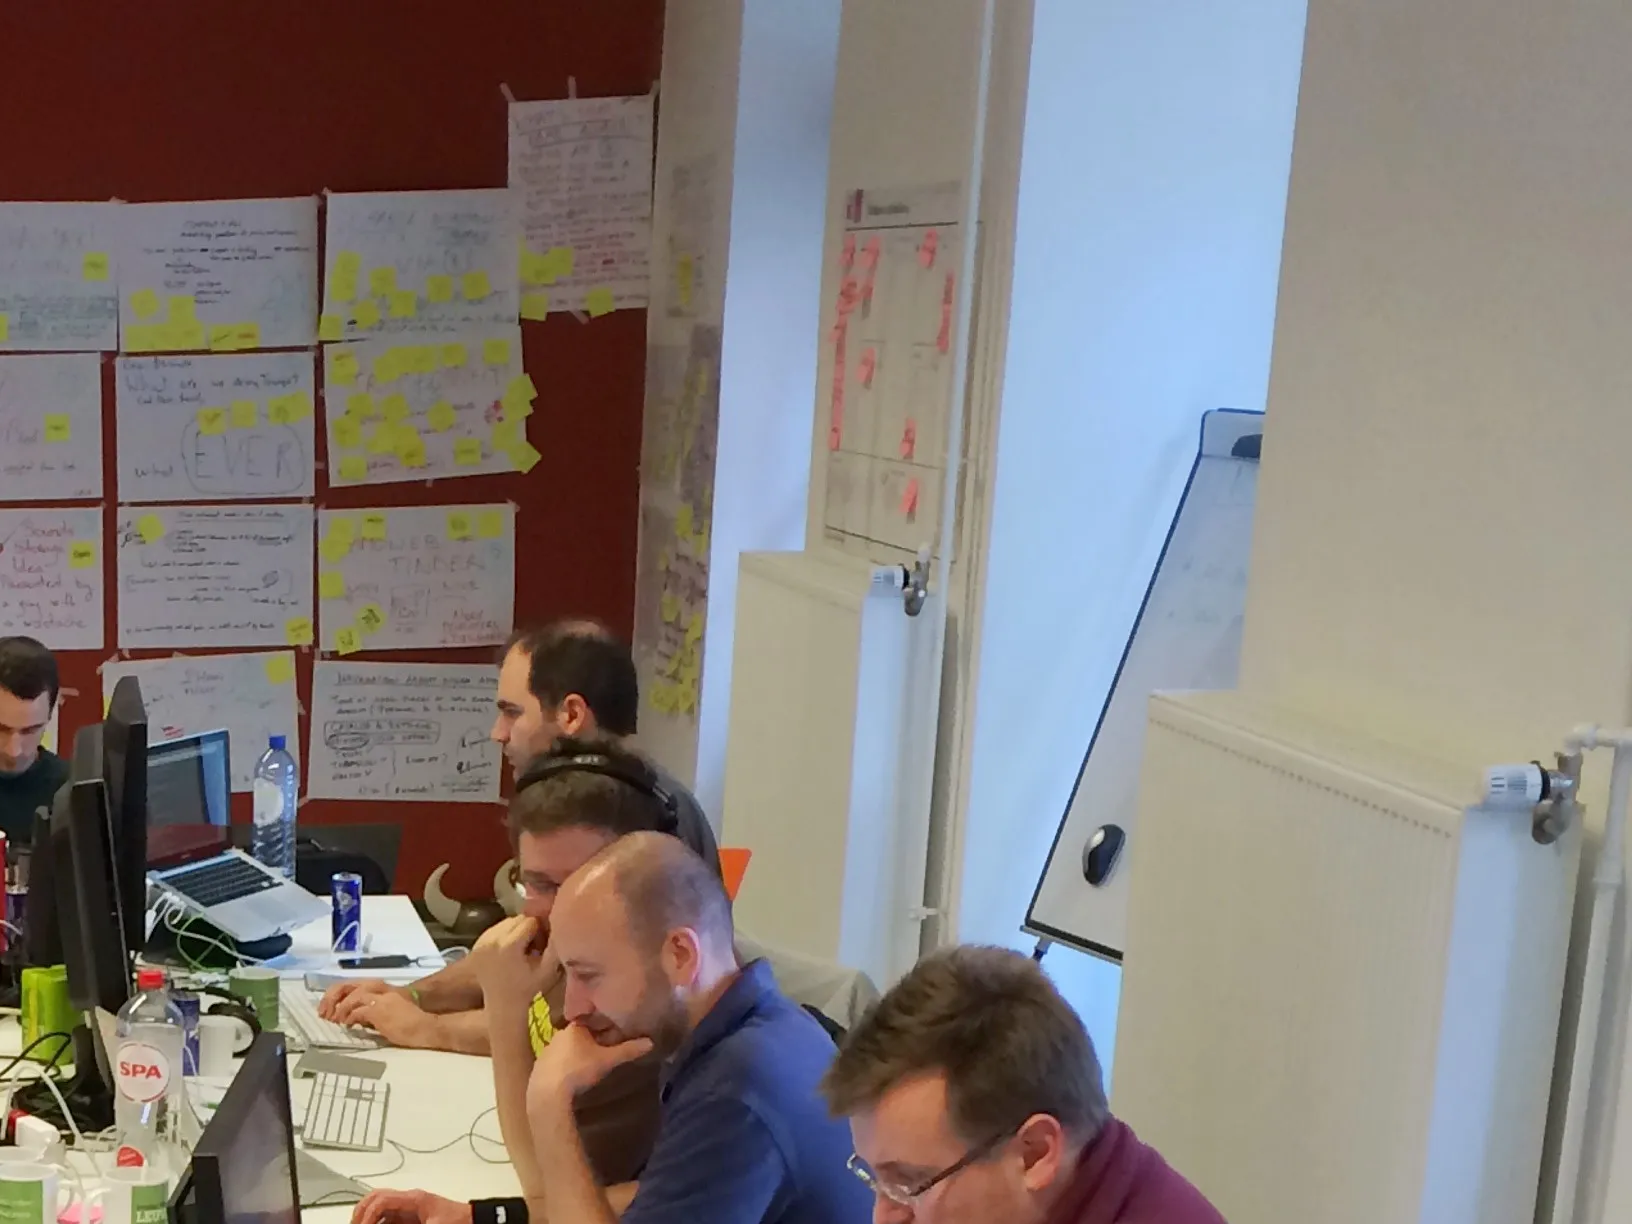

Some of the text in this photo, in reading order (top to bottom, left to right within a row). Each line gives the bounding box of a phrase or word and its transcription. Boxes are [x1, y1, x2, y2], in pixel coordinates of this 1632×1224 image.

[194, 431, 294, 482] EVER
[388, 554, 485, 575] TINDER
[119, 1060, 163, 1079] SPA
